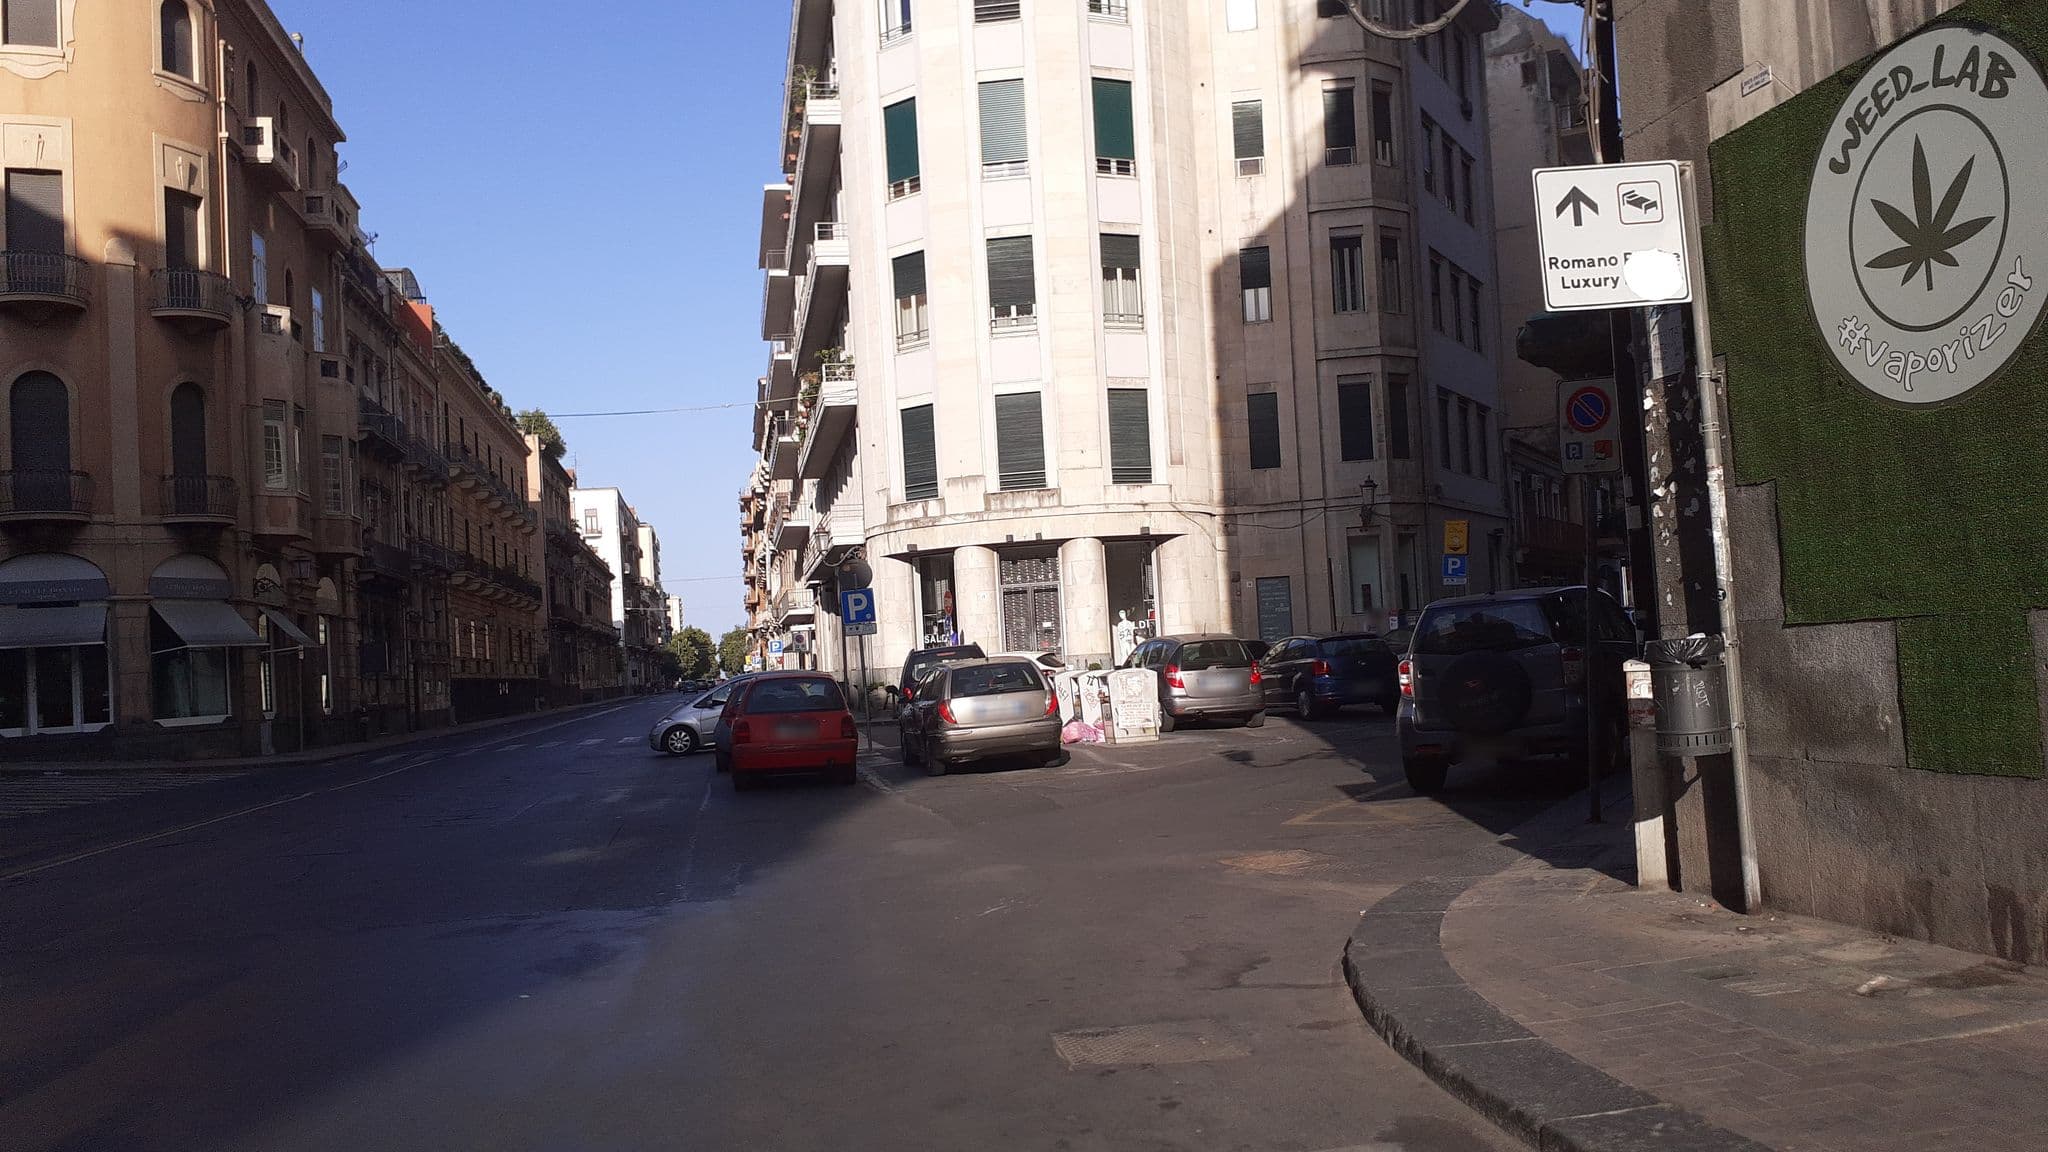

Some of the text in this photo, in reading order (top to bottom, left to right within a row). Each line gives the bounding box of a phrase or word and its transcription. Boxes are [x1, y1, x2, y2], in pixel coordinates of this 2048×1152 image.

[1549, 255, 1619, 270] Romano
[1561, 275, 1620, 290] Luxury
[1838, 255, 2033, 392] #vaporizer
[1447, 558, 1461, 575] P
[847, 593, 868, 621] P
[924, 633, 949, 644] SALD
